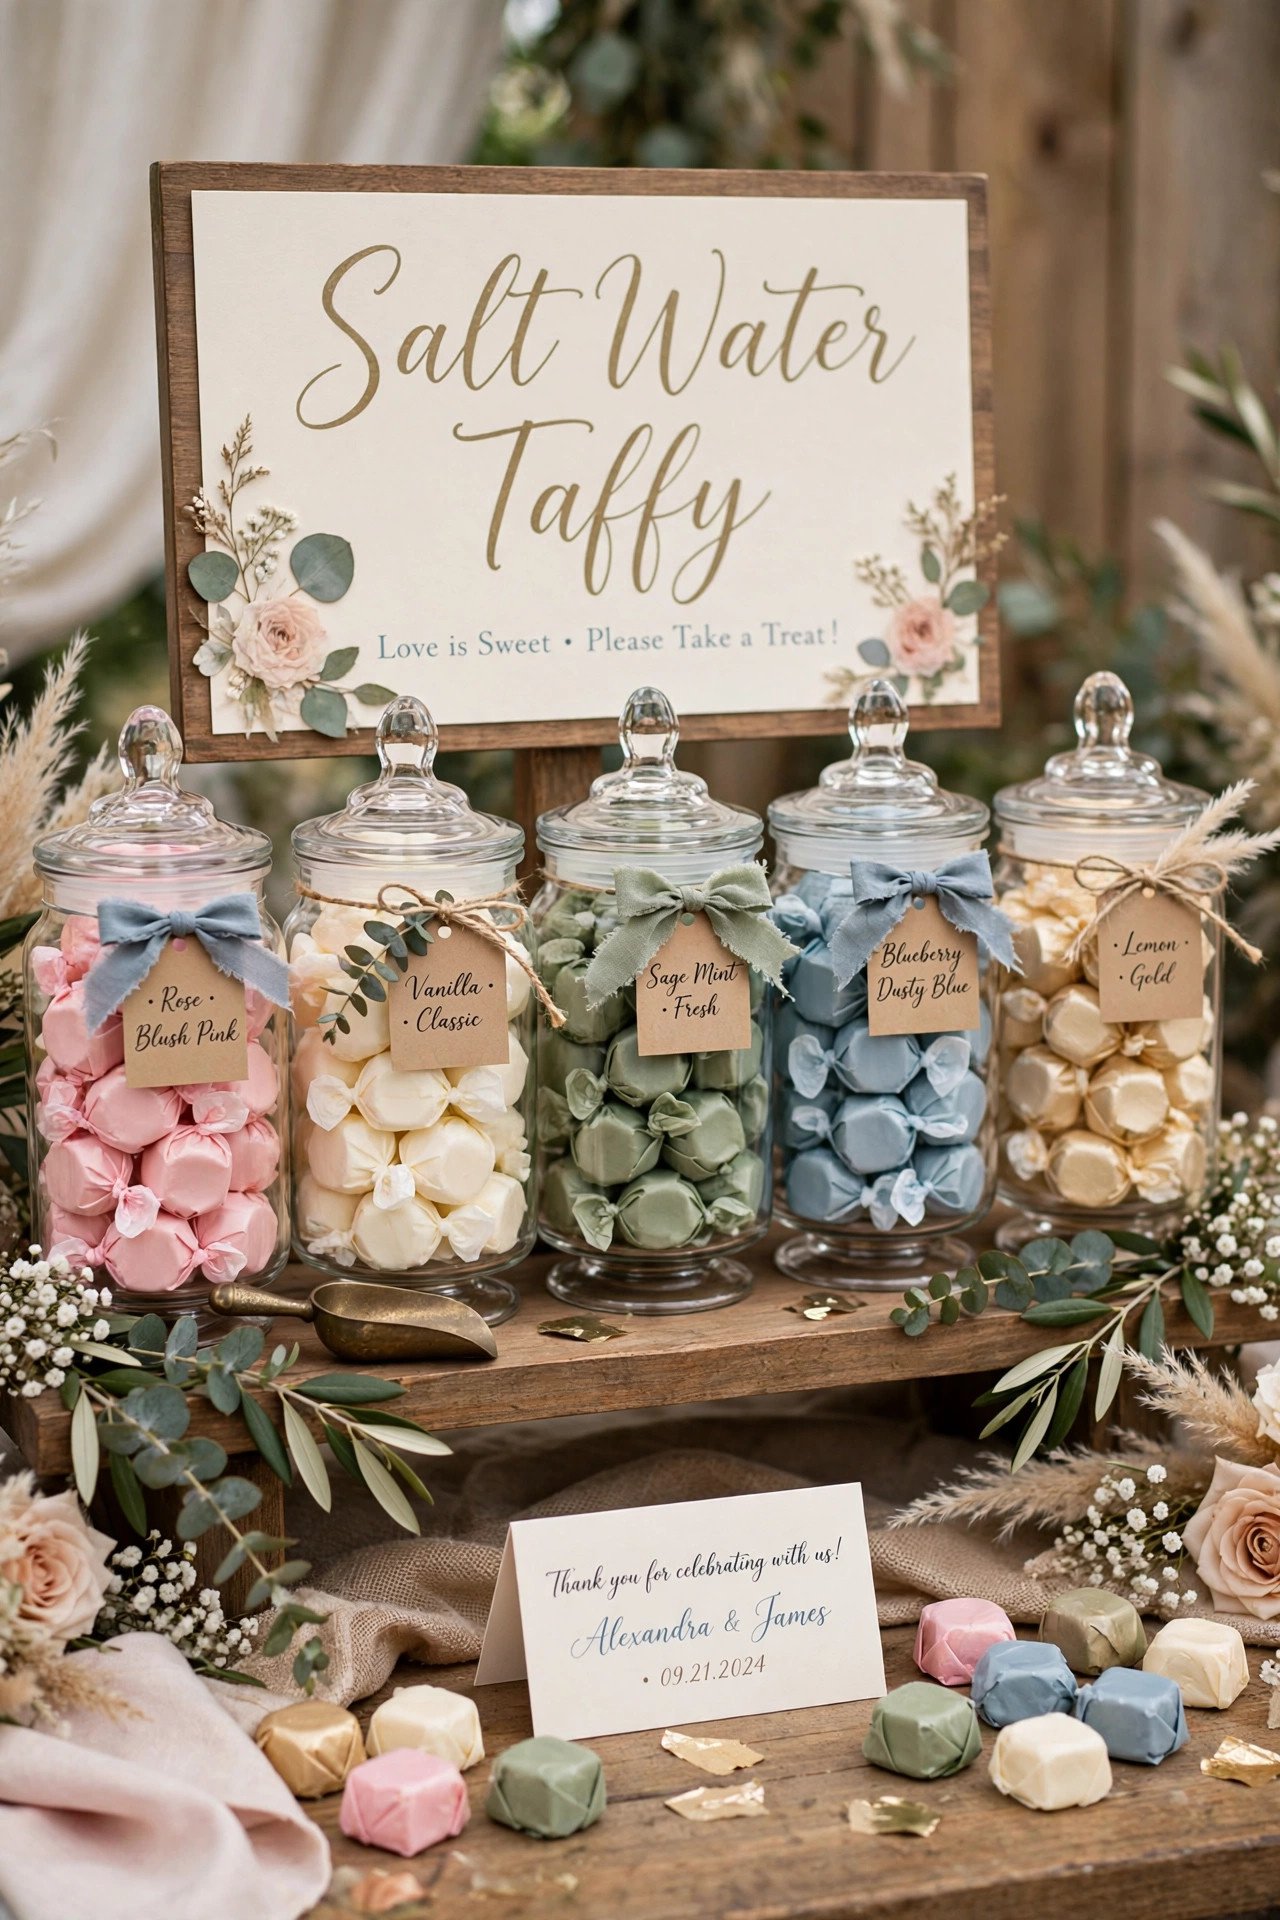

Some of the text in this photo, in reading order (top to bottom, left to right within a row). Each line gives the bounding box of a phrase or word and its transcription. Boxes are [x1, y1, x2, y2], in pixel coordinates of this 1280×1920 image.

[296, 243, 917, 430] Salt Water
[452, 417, 773, 606] Taffy
[377, 618, 840, 662] Love is Sweet Please Take a Treat!
[880, 940, 965, 974] Blueberry
[1121, 930, 1180, 957] Lemon
[404, 972, 484, 1000] Vanilla
[646, 961, 742, 996] Sage Mint
[876, 973, 972, 1008] Dusty Blue
[1129, 961, 1178, 991] Gold
[160, 985, 204, 1013] Rose
[673, 994, 722, 1020] Fresh
[134, 1017, 241, 1053] Blush Pink
[416, 1005, 484, 1034] Classic
[545, 1536, 843, 1600] Thank you for celebrating with us!
[570, 1591, 832, 1659] Alexandra & James
[659, 1653, 766, 1687] 09.21.2024
